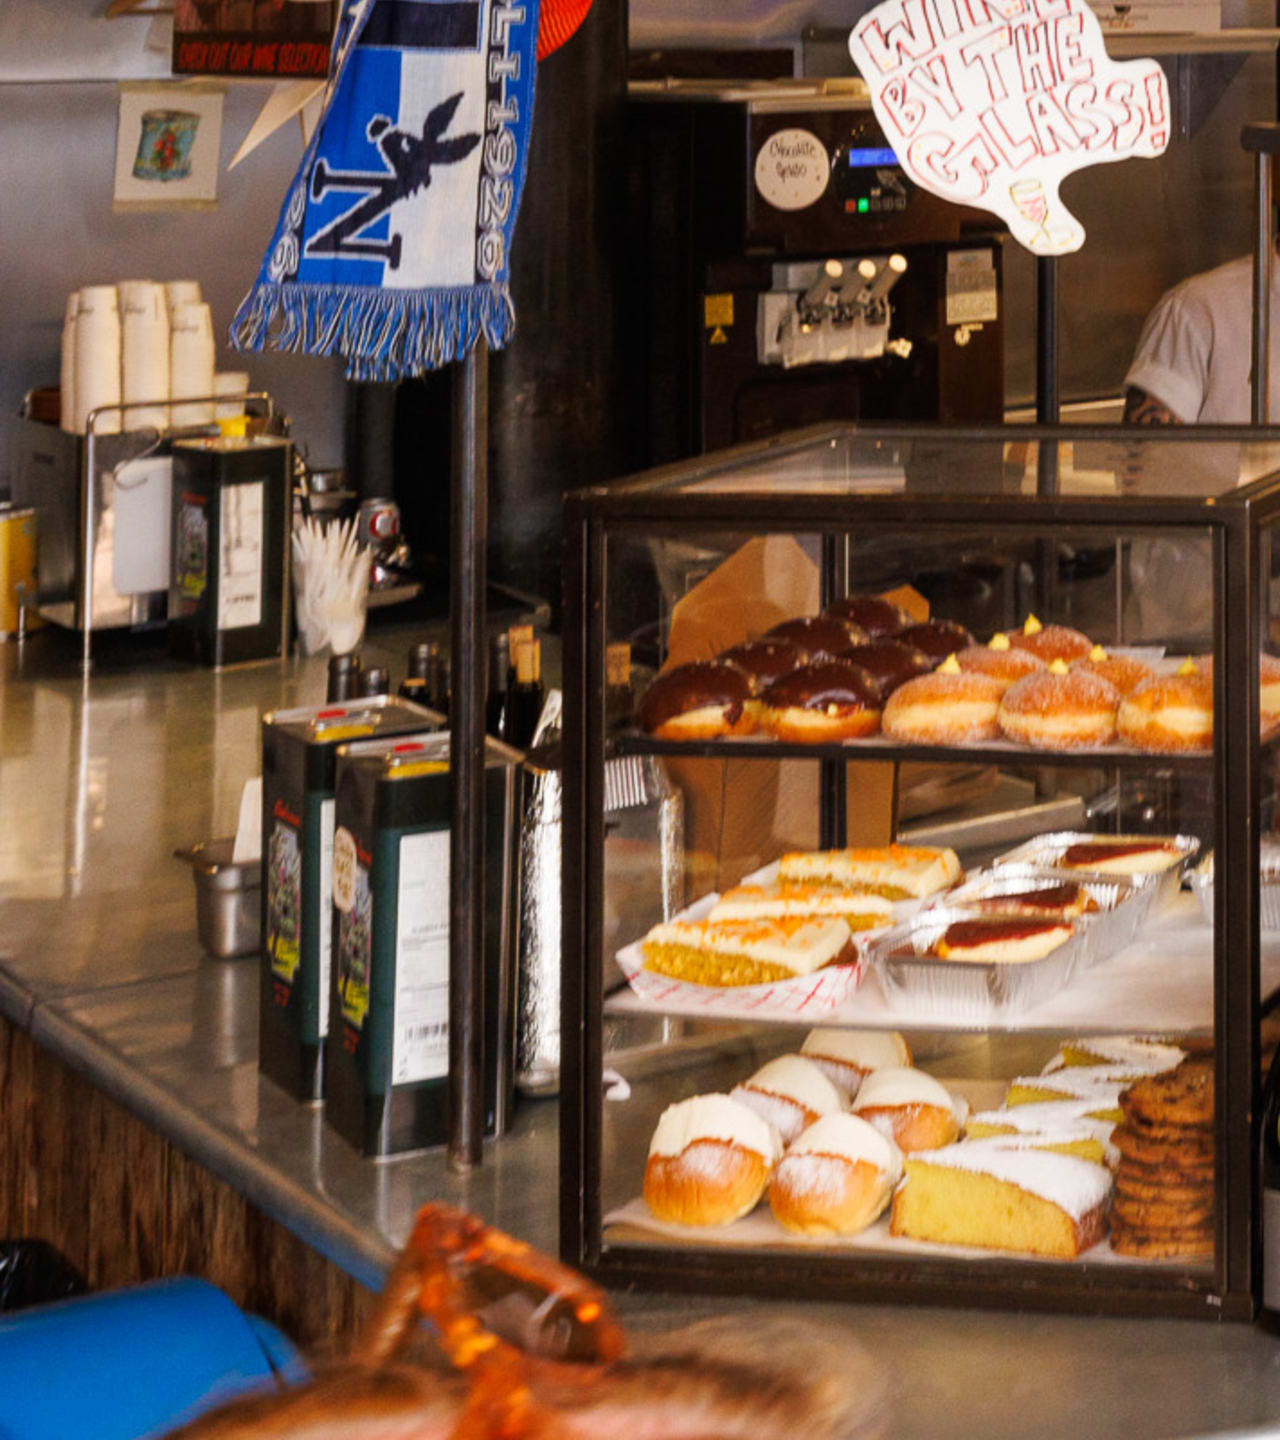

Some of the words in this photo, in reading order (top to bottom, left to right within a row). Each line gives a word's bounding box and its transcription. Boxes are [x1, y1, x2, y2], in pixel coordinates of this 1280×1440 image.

[880, 54, 963, 139] BY
[959, 11, 1095, 103] THE
[907, 71, 1168, 202] GLASS!
